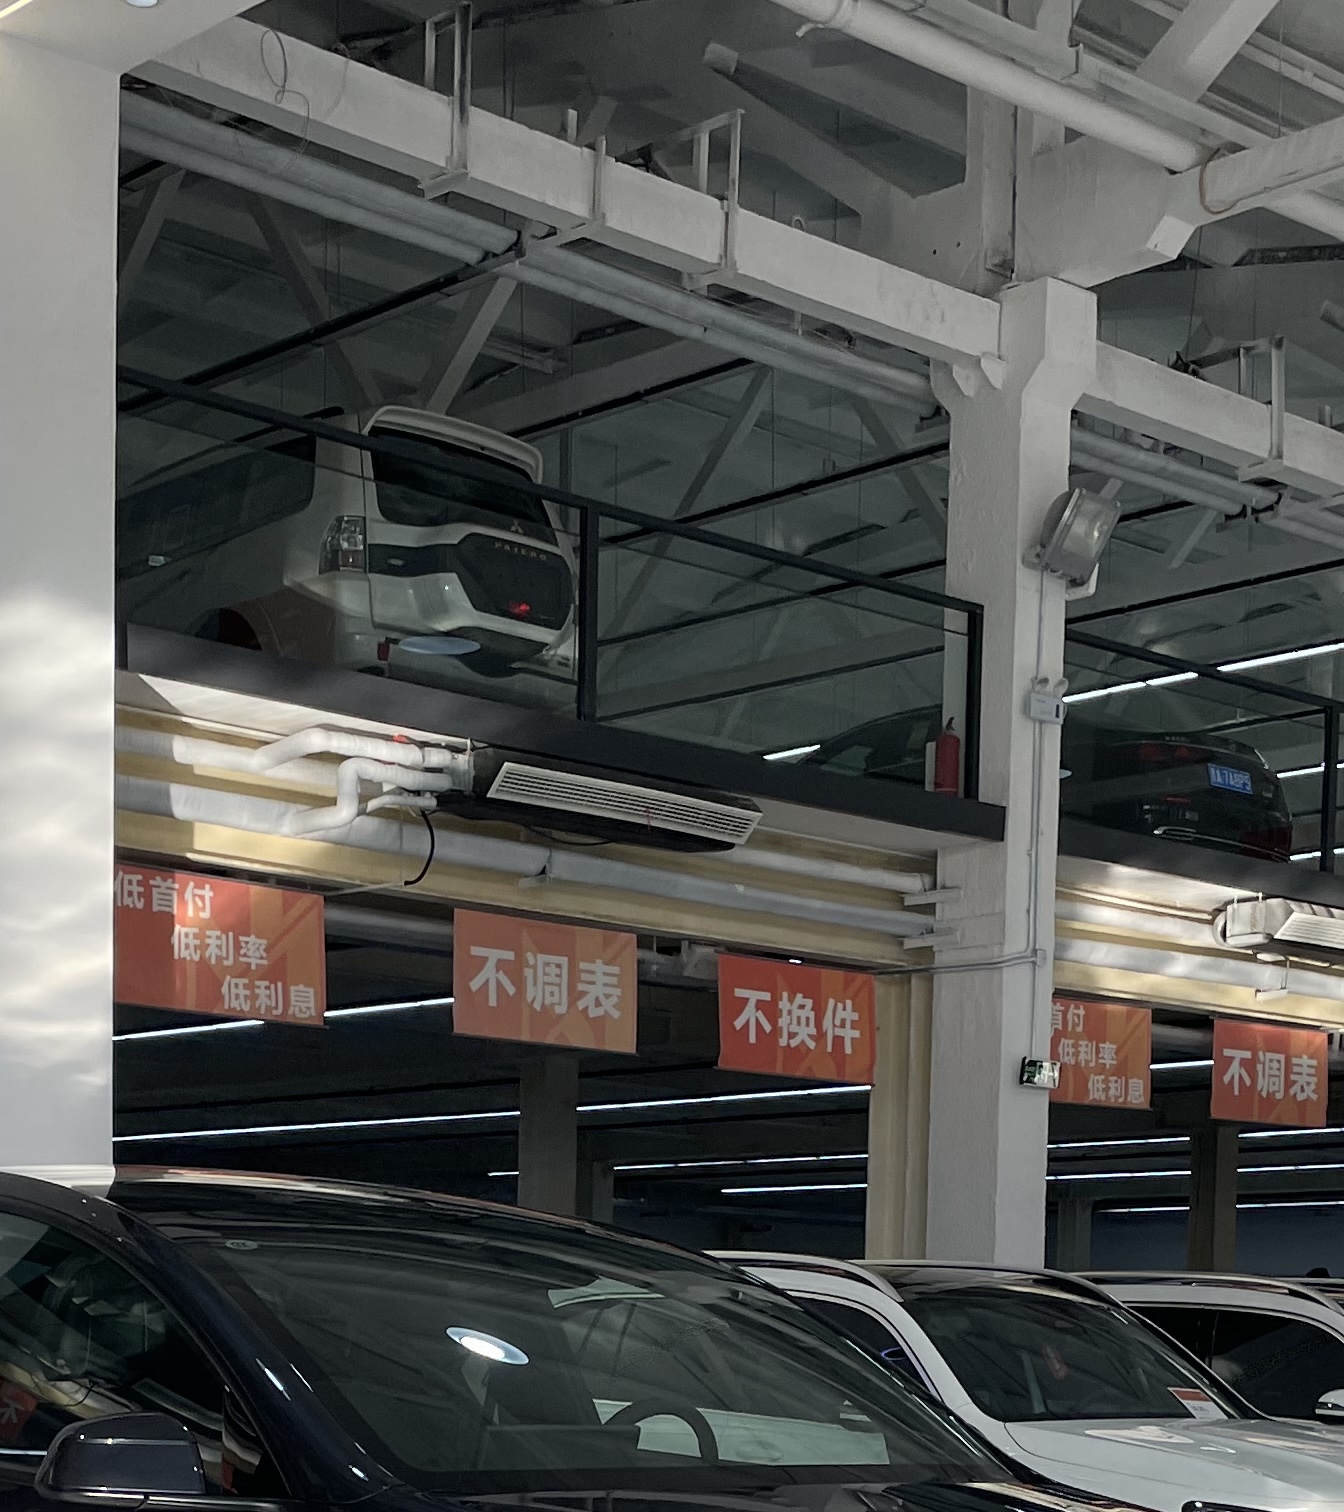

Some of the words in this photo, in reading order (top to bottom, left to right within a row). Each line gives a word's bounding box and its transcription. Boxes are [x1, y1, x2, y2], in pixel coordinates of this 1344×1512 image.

[113, 870, 214, 920] 低首付
[171, 923, 269, 969] 低利率
[220, 974, 317, 1019] 低利息
[468, 946, 623, 1021] 不调表
[732, 987, 862, 1055] 不换件
[1058, 1038, 1118, 1069] 低利率
[1222, 1048, 1319, 1102] 不调表
[1088, 1073, 1145, 1104] 低利息
